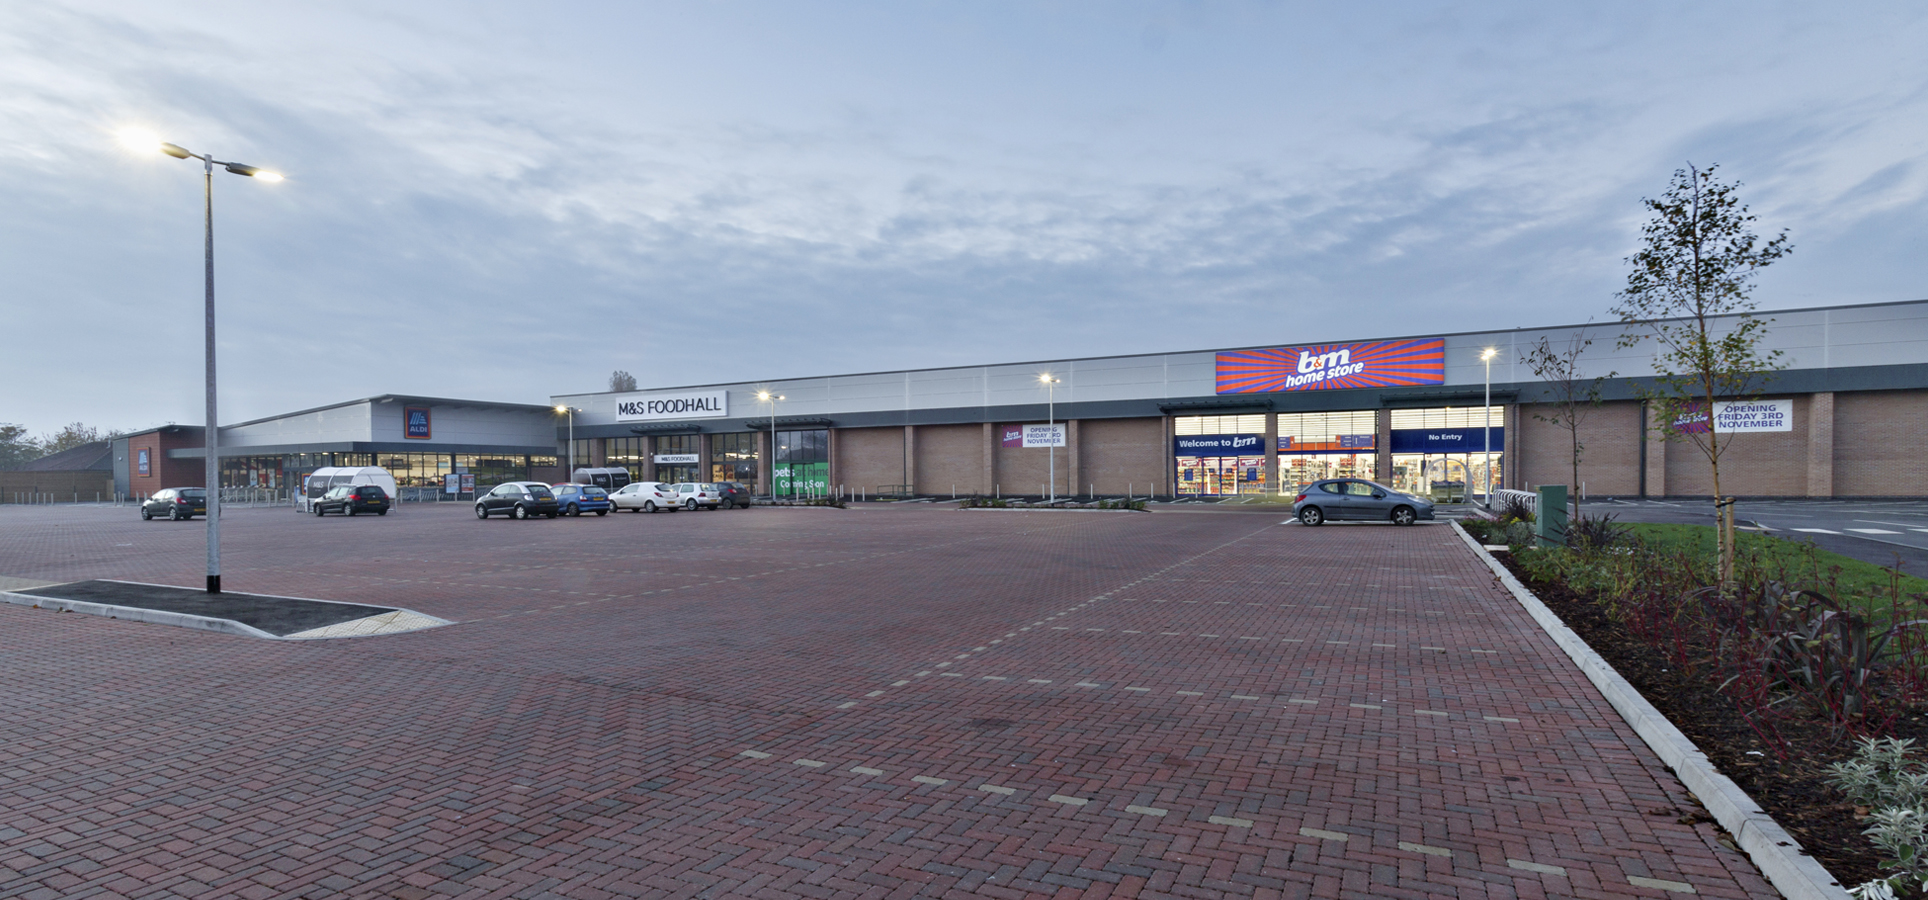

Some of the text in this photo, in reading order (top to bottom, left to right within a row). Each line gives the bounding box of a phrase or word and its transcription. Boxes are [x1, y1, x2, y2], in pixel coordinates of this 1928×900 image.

[1297, 349, 1350, 374] b&m
[1285, 362, 1364, 388] home store
[618, 397, 721, 415] M&S FOODHALL
[1725, 405, 1776, 413] OPENING
[1719, 420, 1783, 428] NOVEMBER
[775, 467, 795, 478] pets
